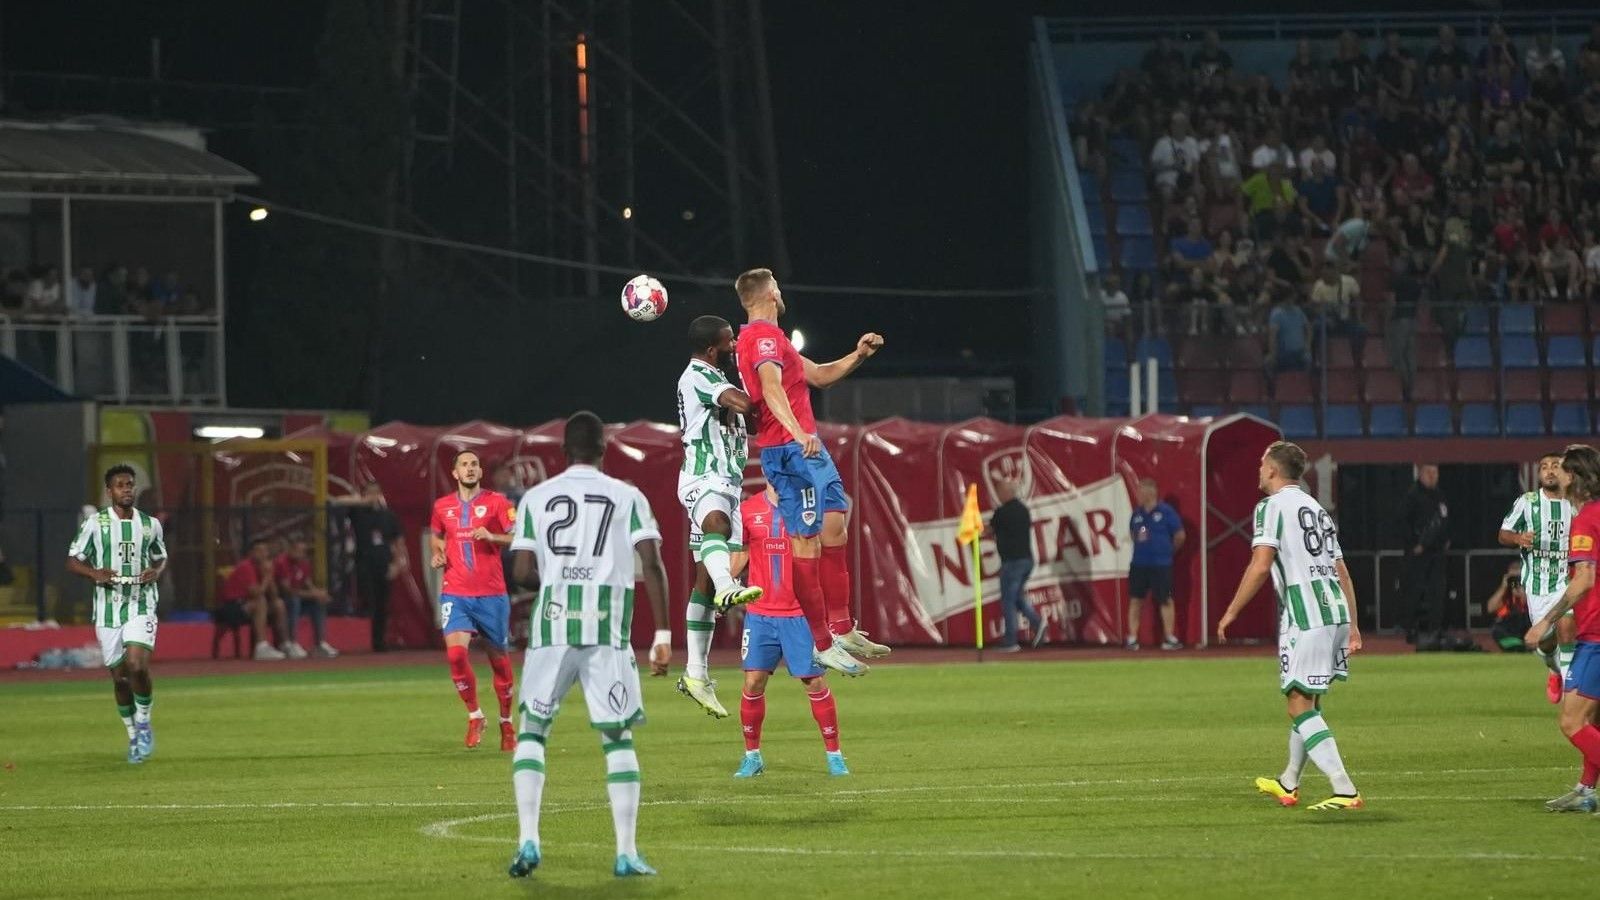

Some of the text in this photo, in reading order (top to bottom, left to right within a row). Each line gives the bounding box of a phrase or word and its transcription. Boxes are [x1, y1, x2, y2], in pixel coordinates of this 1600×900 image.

[801, 487, 816, 508] 19
[545, 494, 616, 557] 27
[1298, 506, 1336, 557] 88
[562, 567, 593, 580] CISSE
[931, 508, 1121, 595] NETAR
